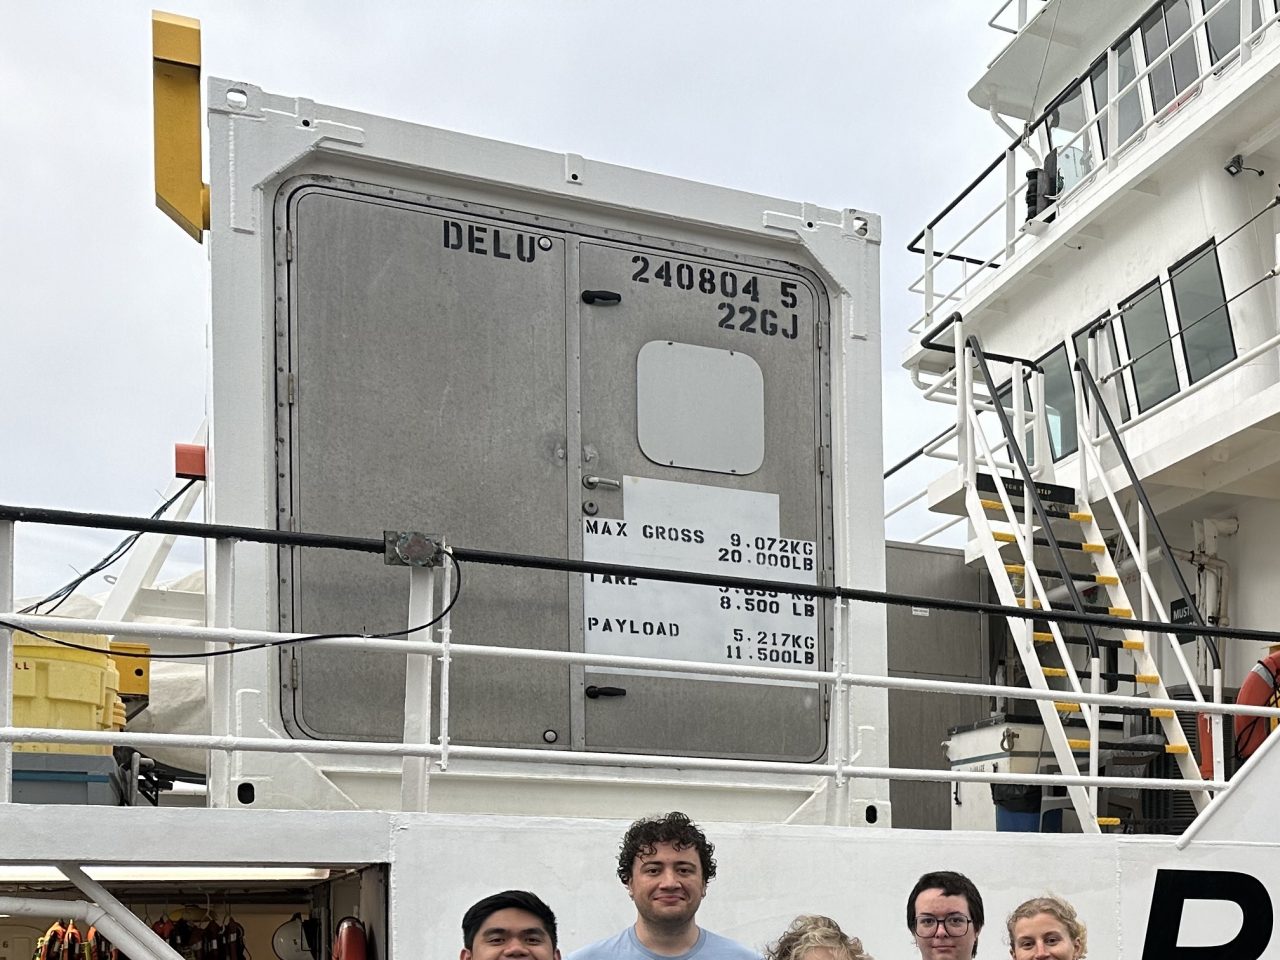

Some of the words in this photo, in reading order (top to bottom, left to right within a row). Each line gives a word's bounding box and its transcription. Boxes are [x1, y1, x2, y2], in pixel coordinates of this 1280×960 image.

[443, 220, 536, 263] DELU
[631, 255, 759, 302] 240804
[780, 281, 797, 308] 5
[717, 303, 798, 340] 22GJ
[586, 519, 628, 537] MAX
[642, 524, 705, 544] GROSS
[730, 533, 813, 556] 9.072KG
[718, 548, 814, 571] 20.000LB
[720, 595, 780, 614] 8.500
[792, 602, 815, 617] LB
[587, 617, 680, 637] PAYLOAD
[733, 628, 815, 650] 5.217KG
[726, 644, 815, 665] 11.500LB
